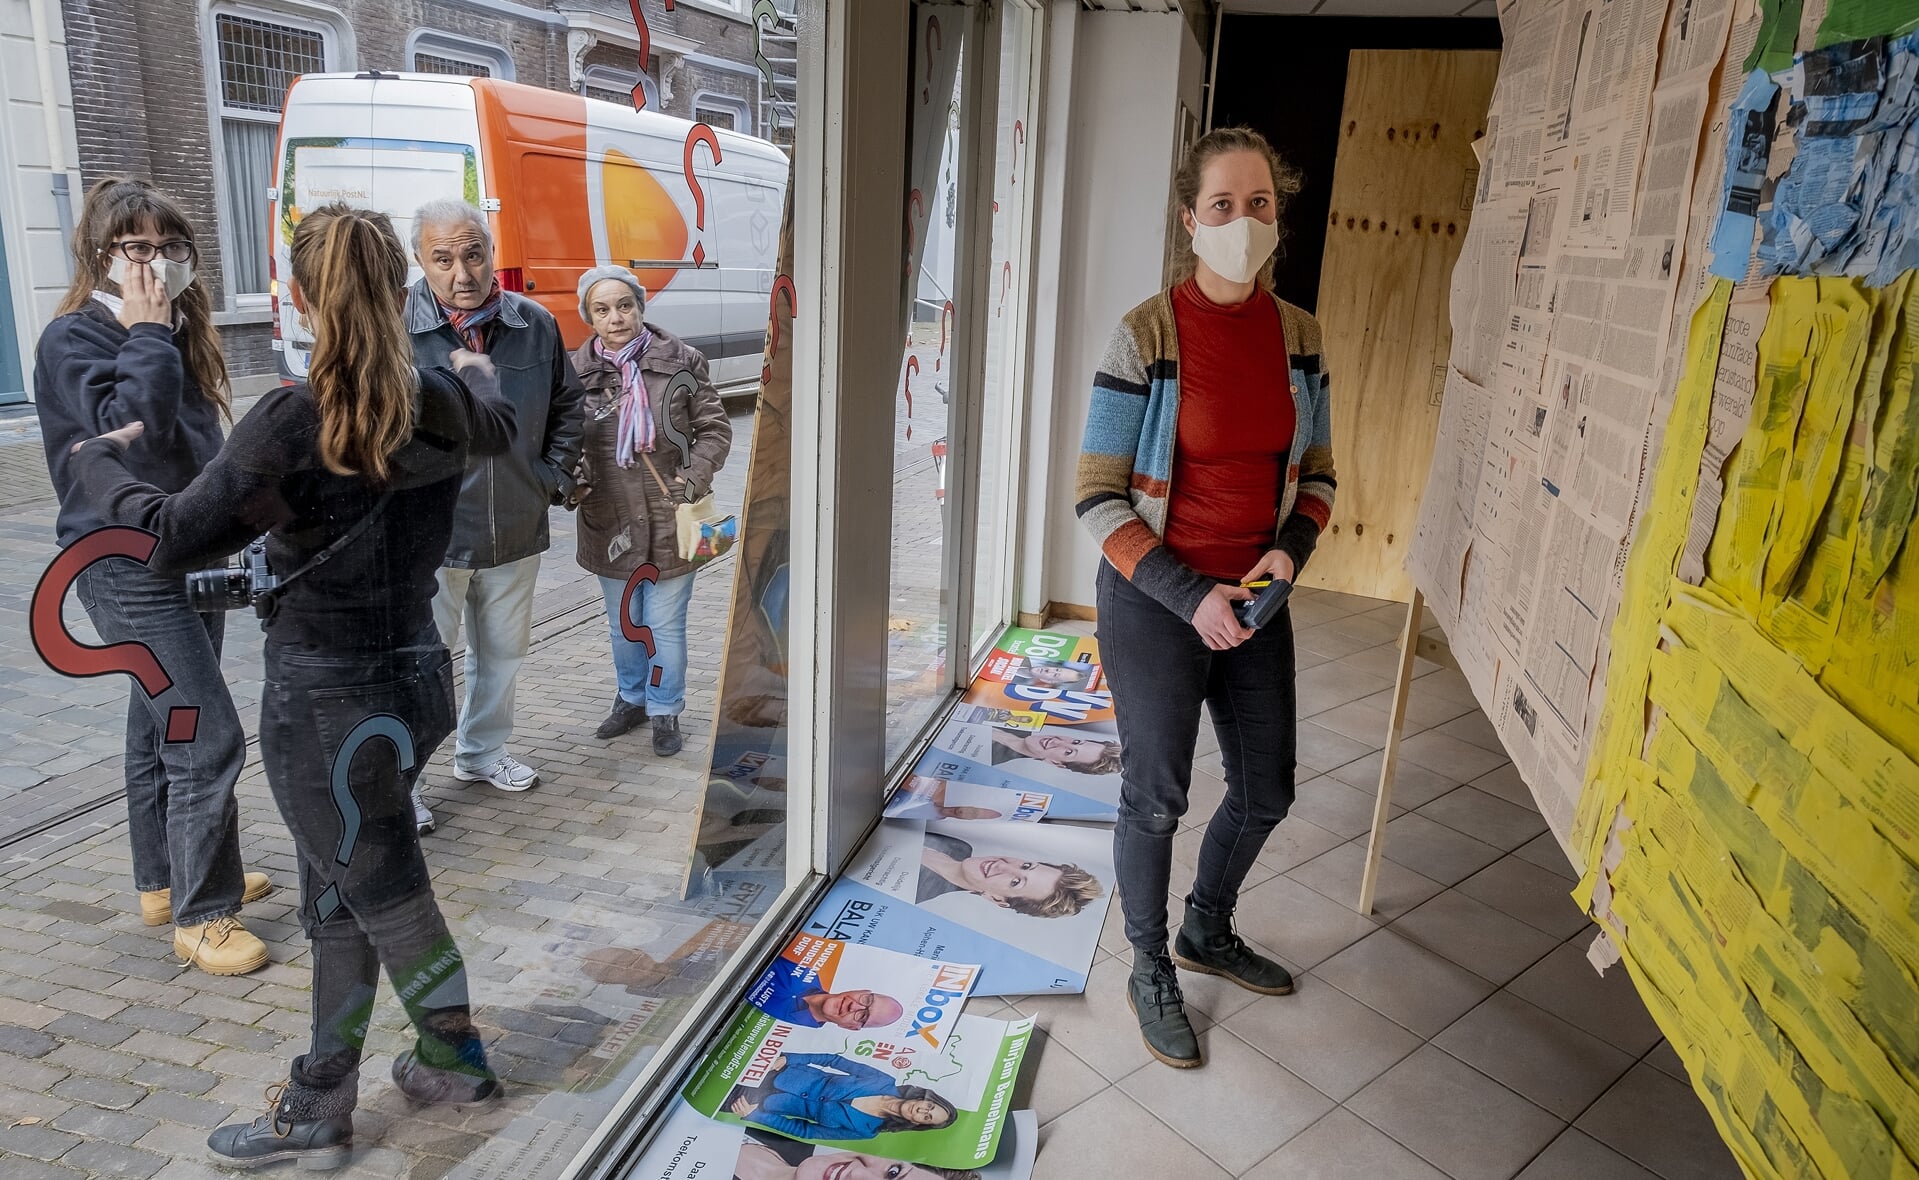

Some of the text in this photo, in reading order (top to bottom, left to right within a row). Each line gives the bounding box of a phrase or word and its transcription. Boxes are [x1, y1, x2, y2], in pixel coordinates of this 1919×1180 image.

[790, 939, 825, 978] DUIDELIJK
[792, 936, 812, 956] DURF
[802, 942, 838, 984] DUURZAAM
[772, 1024, 793, 1038] IN
[740, 1038, 784, 1084] BOXTEL
[973, 1036, 1026, 1160] Mirjam Bemelmans
[657, 1135, 698, 1180] Toekomst
